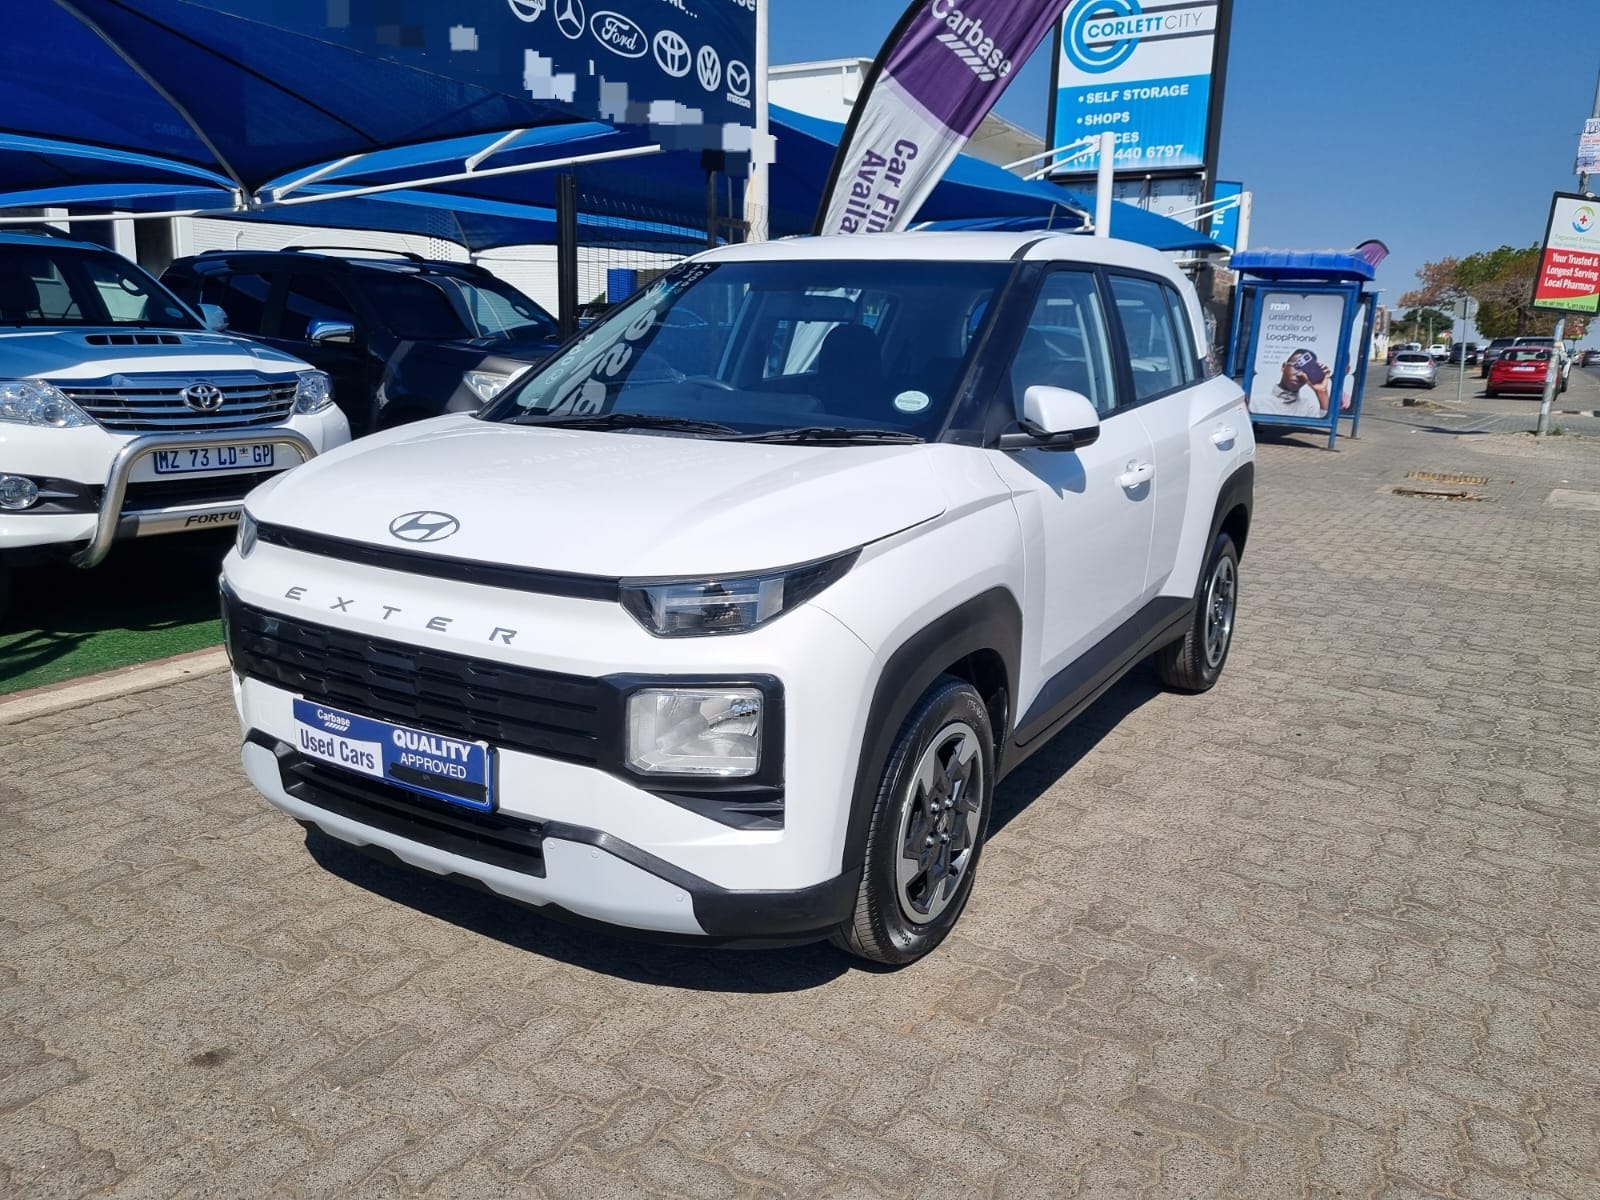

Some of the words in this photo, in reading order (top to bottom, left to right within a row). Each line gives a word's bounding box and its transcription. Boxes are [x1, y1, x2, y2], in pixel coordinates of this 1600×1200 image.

[601, 17, 637, 51] Ford
[1086, 16, 1163, 39] CORLETT
[1164, 12, 1203, 31] CITY
[931, 0, 1012, 78] Carbase
[1086, 91, 1119, 104] SELF
[1123, 84, 1190, 101] STORAGE
[1084, 111, 1130, 125] SHOPS
[1115, 147, 1142, 160] 440
[1146, 144, 1184, 159] 6797
[887, 139, 919, 189] Car
[1552, 252, 1568, 263] Your
[1568, 254, 1593, 266] Trusted
[1592, 257, 1599, 267] &
[1546, 264, 1573, 277] Longest
[1574, 267, 1599, 281] Serving
[1544, 277, 1563, 288] Local
[1562, 279, 1596, 293] Pharmacy
[1270, 301, 1290, 311] rain
[1268, 312, 1312, 322] unlimited
[1267, 322, 1299, 332] mobile
[1266, 332, 1317, 343] LoopPhone
[158, 450, 180, 469] MZ
[190, 448, 209, 467] 73
[218, 447, 237, 465] LD
[253, 445, 270, 463] GP
[285, 586, 517, 645] EXTER
[317, 709, 350, 727] Carbase
[300, 728, 335, 758] Used
[339, 741, 375, 770] Cars
[393, 730, 472, 762] QUALITY
[400, 752, 467, 779] APPROVED
